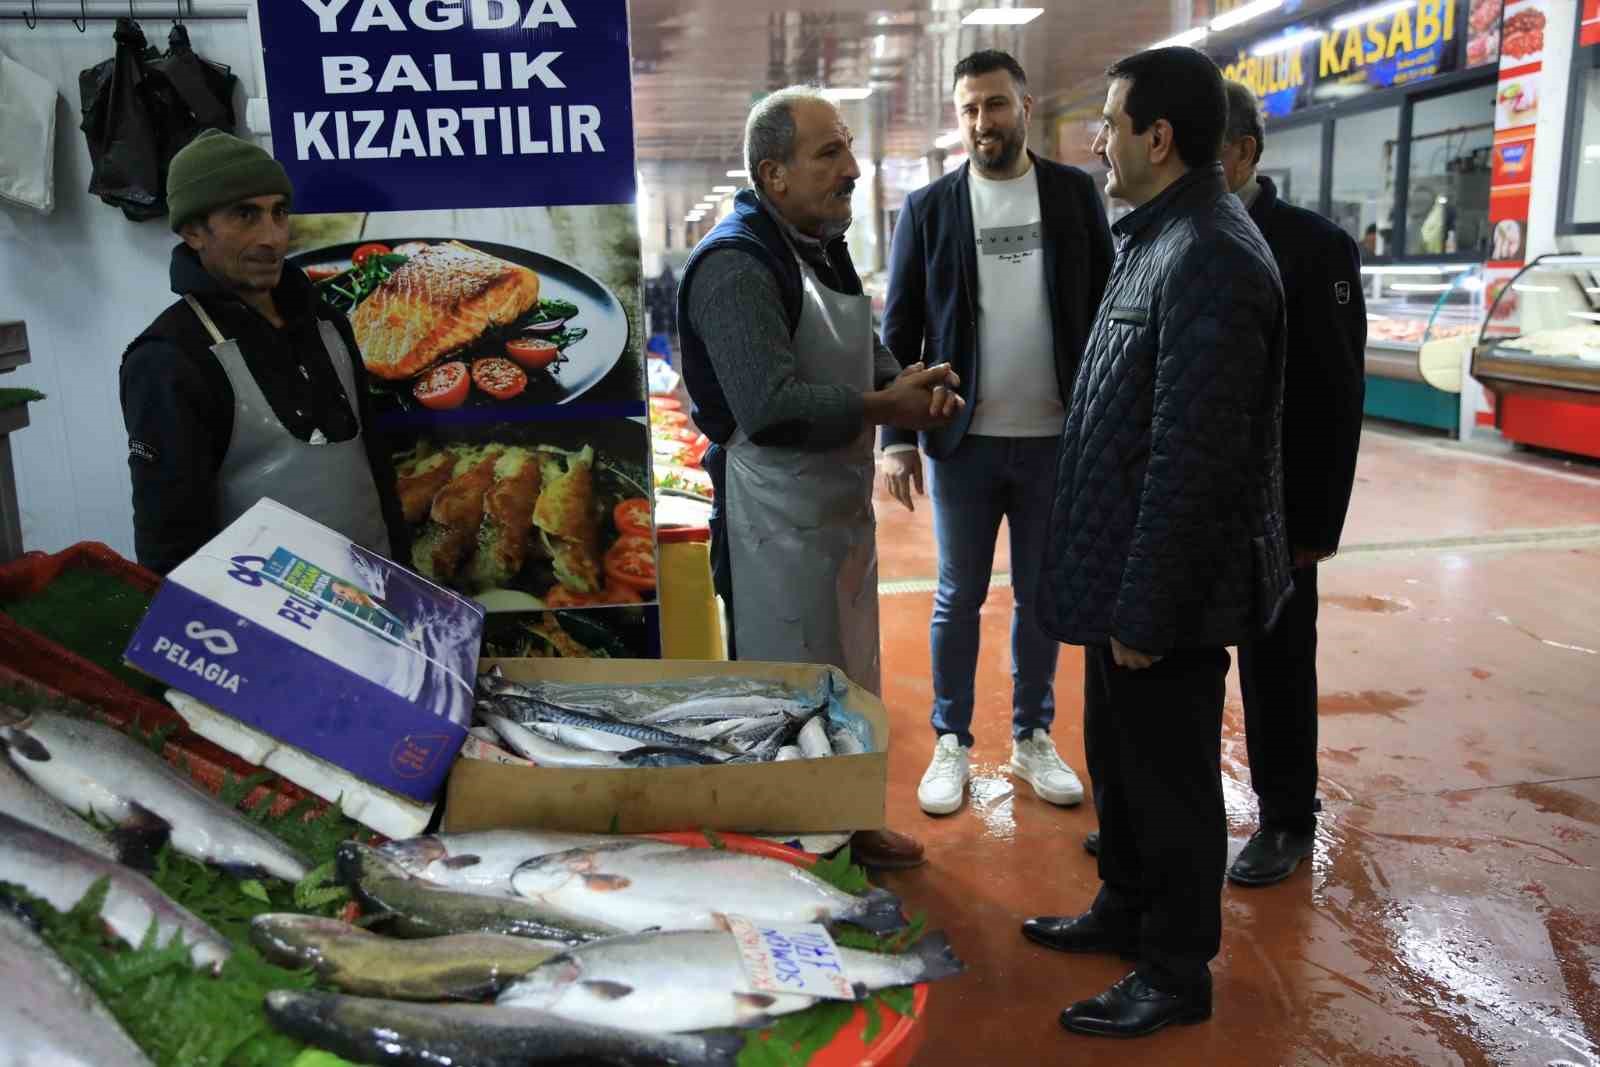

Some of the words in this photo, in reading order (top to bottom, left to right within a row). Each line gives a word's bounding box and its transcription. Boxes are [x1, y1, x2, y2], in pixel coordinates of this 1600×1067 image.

[321, 51, 568, 94] BALIK
[293, 104, 606, 161] KIZARTILIR
[152, 635, 241, 694] PELAGIA
